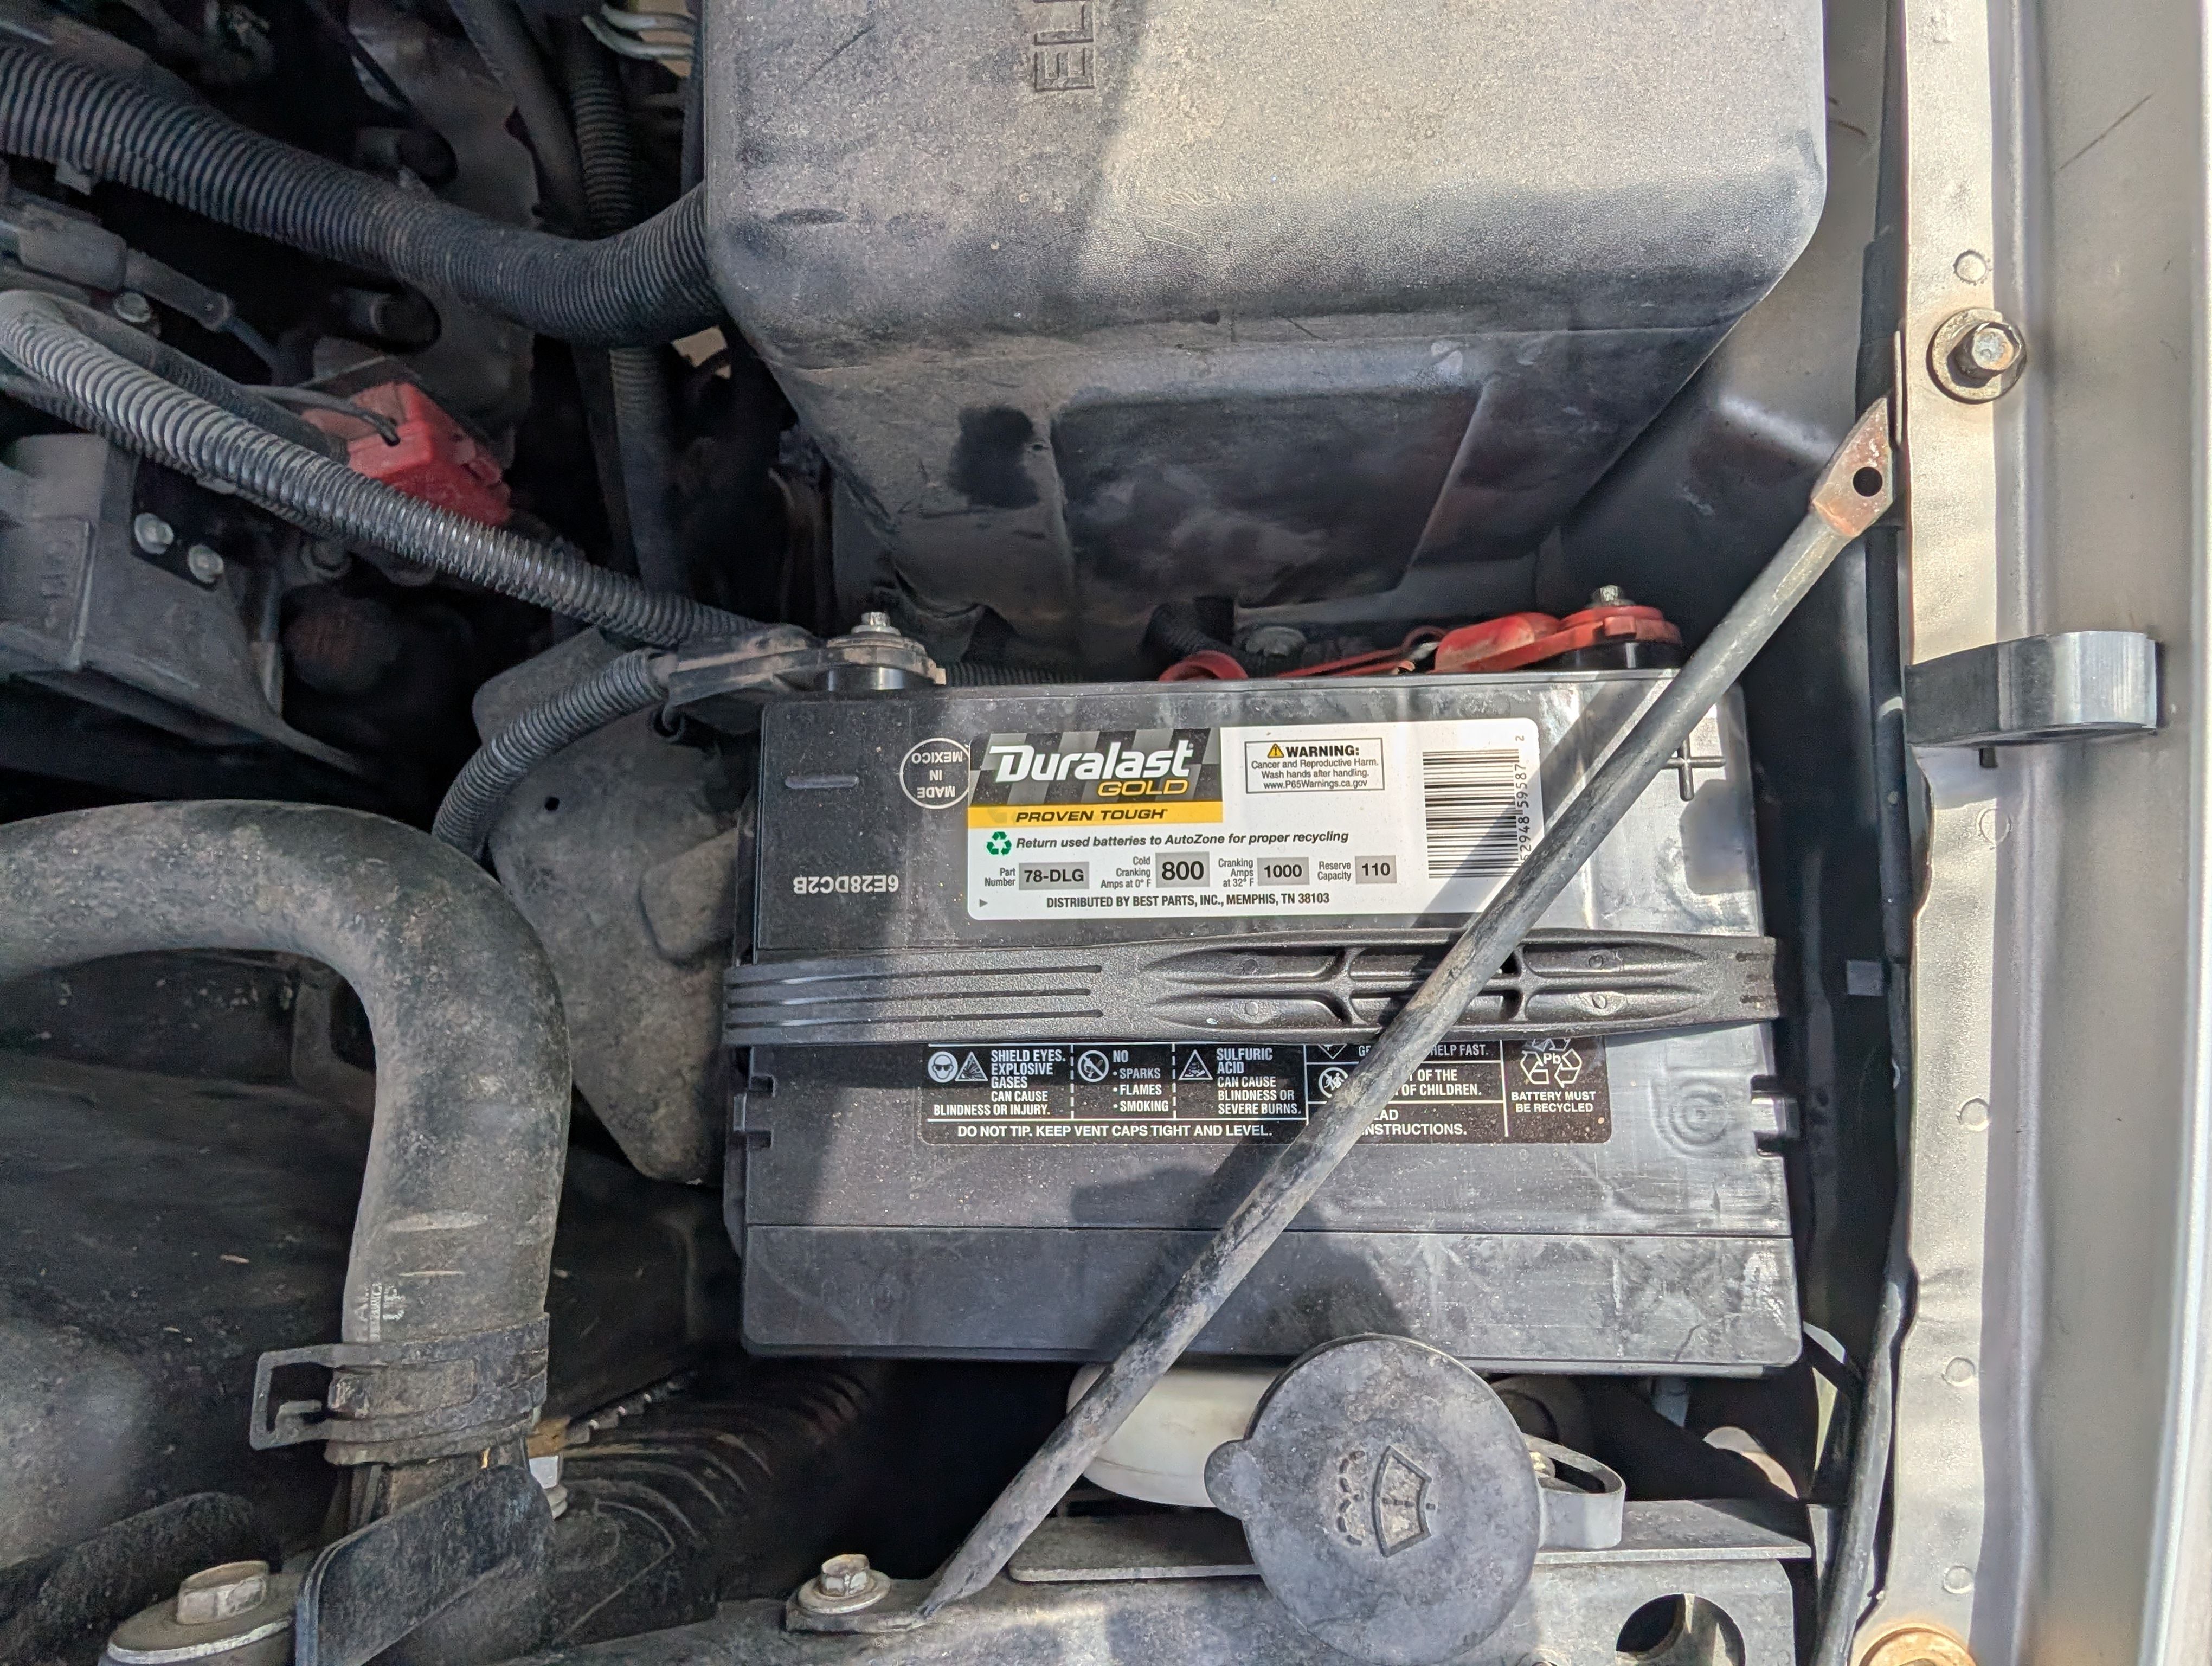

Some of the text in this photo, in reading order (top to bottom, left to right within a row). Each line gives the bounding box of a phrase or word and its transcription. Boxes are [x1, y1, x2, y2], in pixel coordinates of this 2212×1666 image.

[1285, 745, 1359, 757] WARNING:
[911, 751, 962, 764] MEXICO
[989, 740, 1193, 783] Duralast
[1251, 760, 1279, 770] Cancer
[1282, 760, 1297, 768] and
[1301, 759, 1351, 770] Reproductive
[929, 770, 942, 781] IN
[1333, 768, 1369, 778] handling.
[1098, 780, 1188, 797] GOLD
[1263, 779, 1367, 789] www.P65Warnings.ca.gov
[1515, 764, 1529, 808] 59587
[917, 786, 955, 798] MADE
[1016, 809, 1165, 822] PROVEN TOUGH
[1017, 831, 1348, 848] Return used batteries to AutoZone for proper recycling
[1133, 856, 1150, 865] Cold
[1218, 859, 1253, 868] Cranking
[1319, 861, 1351, 870] Reserve
[1000, 868, 1015, 876] Part
[1116, 868, 1150, 878] Cranking
[1161, 861, 1204, 880] 800
[1231, 869, 1253, 877] Amps
[1264, 864, 1302, 878] 1000
[1362, 863, 1390, 876] 110
[1024, 869, 1084, 882] 78-DLG
[1317, 872, 1351, 881] Capacity
[793, 875, 899, 894] 6E28DC2B
[985, 878, 1015, 887] Number
[1101, 880, 1123, 889] Amps
[1135, 880, 1144, 888] 0°
[1233, 878, 1246, 887] 32°
[1249, 879, 1254, 887] F
[1047, 893, 1329, 908] DISTRIBUTED BY BEST PARTS, INC., MEMPHIS, TN 38103
[991, 1049, 1065, 1062] SHIELD EYES.
[1113, 1050, 1128, 1062] NO
[1217, 1048, 1272, 1061] SULFURIC
[1430, 1045, 1457, 1056] HELP
[1459, 1045, 1488, 1055] FAST.
[1544, 1053, 1561, 1064] Pb
[991, 1063, 1053, 1075] EXPLOSIVE
[1120, 1068, 1160, 1079] SPARKS
[1217, 1062, 1244, 1074] ACID
[1418, 1069, 1432, 1081] OF
[1435, 1069, 1457, 1081] THE
[991, 1077, 1027, 1088] GASES
[1218, 1077, 1276, 1087] CAN CAUSE
[1120, 1085, 1162, 1095] FLAMES
[1402, 1084, 1417, 1095] OF
[1419, 1084, 1482, 1095] CHILDREN.
[991, 1091, 1048, 1101] CAN CAUSE
[1218, 1090, 1294, 1101] BLINDNESS OR
[1512, 1091, 1596, 1101] BATTERY MUST
[934, 1104, 1050, 1116] BLINDNESS OR INJURY.
[1120, 1101, 1169, 1111] SMOKING
[1218, 1103, 1301, 1114] SEVERE BURNS.
[1516, 1103, 1593, 1112] BE RECYCLED
[958, 1125, 1272, 1137] DO NOT TIP. KEEP VENT CAPS TIGHT AND LEVEL.
[1361, 1124, 1467, 1135] NSTRUCTIONS.
